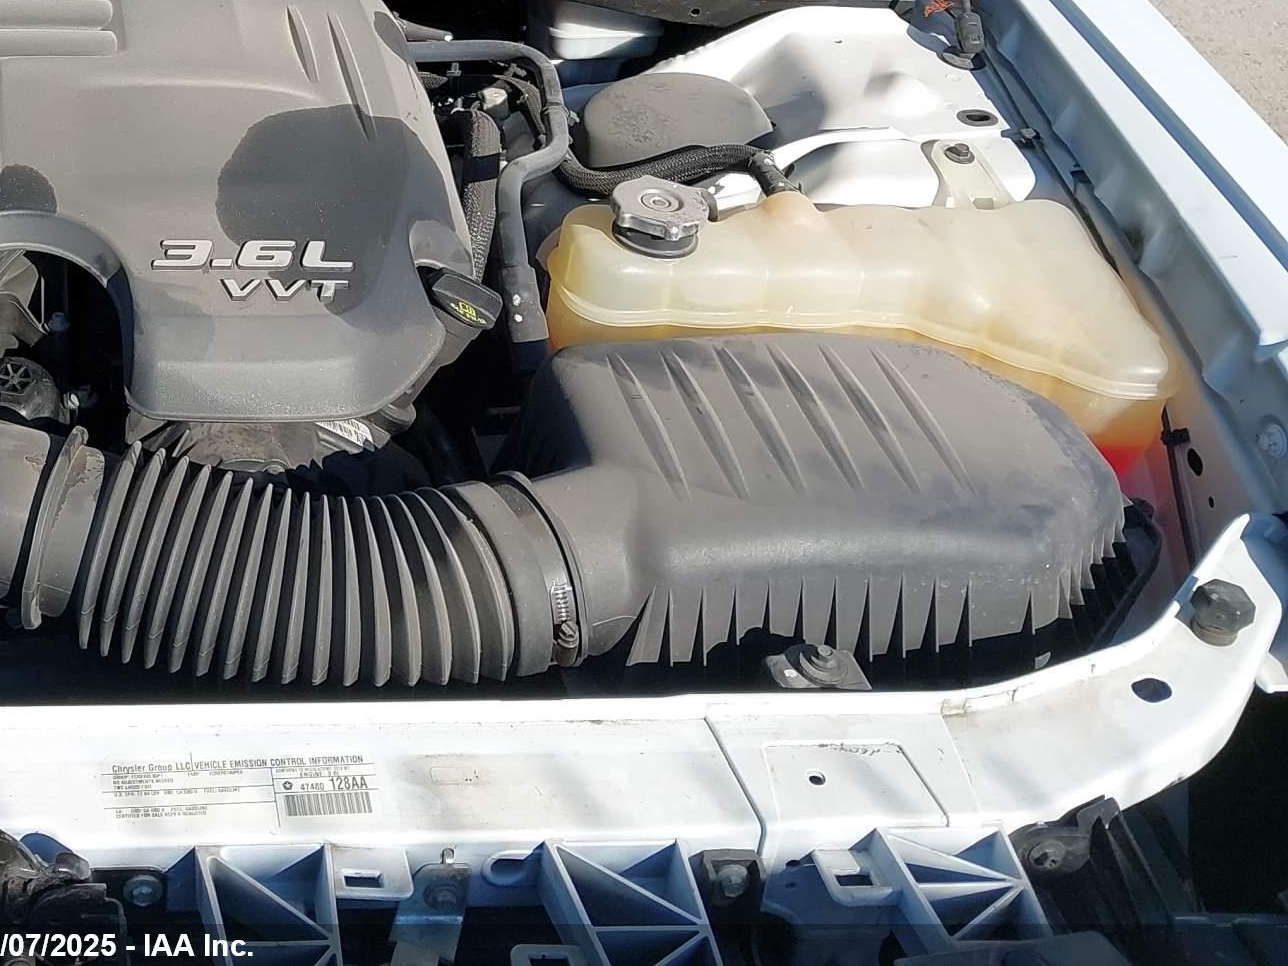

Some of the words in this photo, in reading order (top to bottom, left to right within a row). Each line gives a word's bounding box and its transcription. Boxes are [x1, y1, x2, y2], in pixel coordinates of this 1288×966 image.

[151, 239, 355, 272] 3.6L
[220, 278, 349, 302] VVT
[112, 764, 145, 775] Chrysler
[148, 763, 172, 773] Group
[175, 762, 191, 771] LLC
[194, 760, 227, 770] VEHICLE
[230, 759, 268, 769] EMISSION
[270, 757, 306, 767] CONTROL
[309, 755, 364, 765] INFORMATION
[328, 776, 369, 790] 128AA
